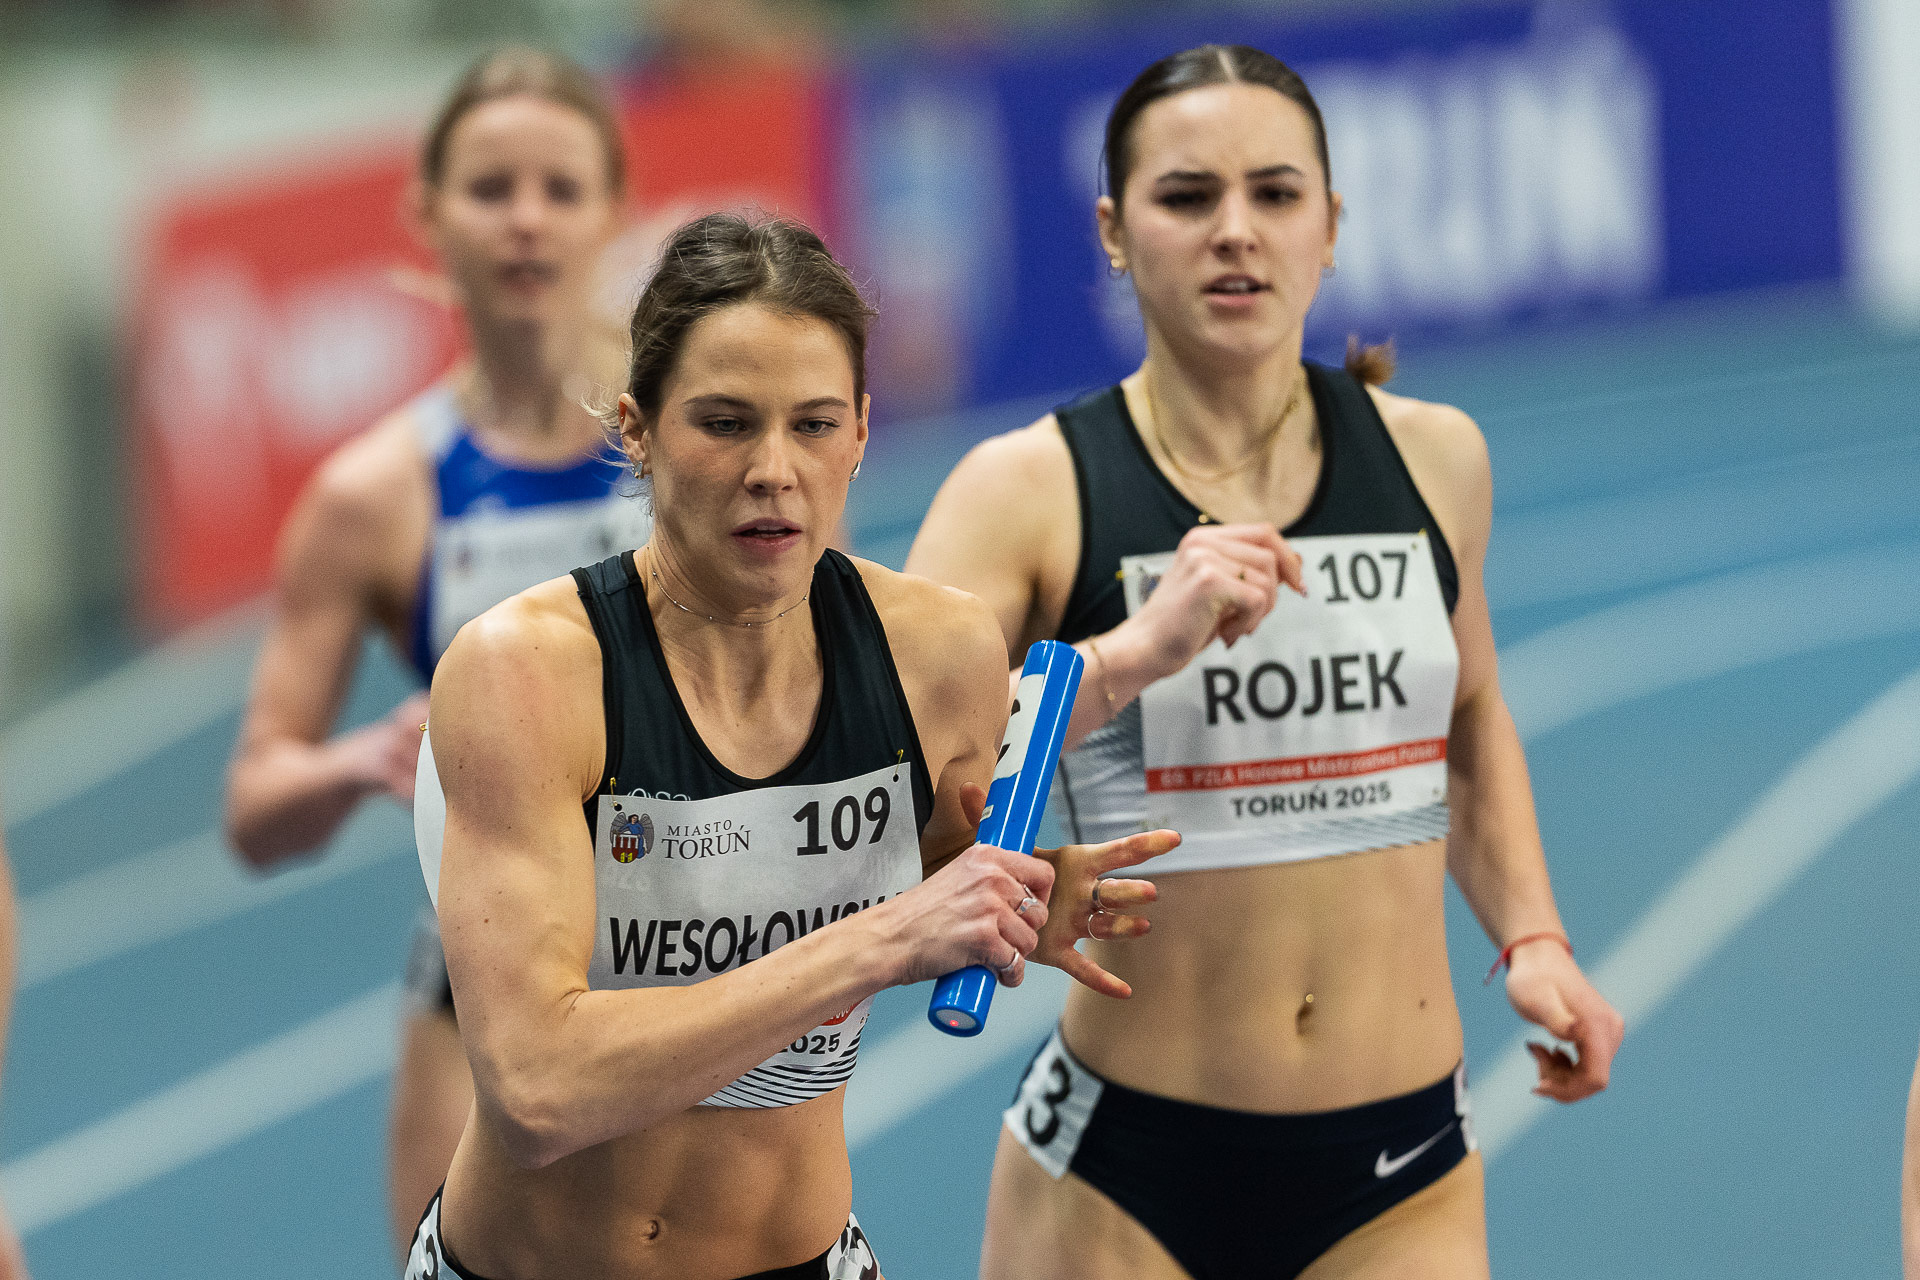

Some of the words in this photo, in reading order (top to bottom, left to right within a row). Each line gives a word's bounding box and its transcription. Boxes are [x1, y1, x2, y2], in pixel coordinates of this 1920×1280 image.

[1318, 551, 1409, 603] 107
[1203, 649, 1408, 725] ROJEK
[792, 787, 891, 856] 109
[1231, 782, 1328, 818] TORUŃ
[1335, 780, 1393, 809] 2025
[661, 824, 751, 860] TORUŃ
[667, 819, 732, 837] MIASTO
[609, 891, 904, 977] WESOŁO
[779, 1031, 842, 1055] 025
[1024, 1056, 1070, 1146] 3
